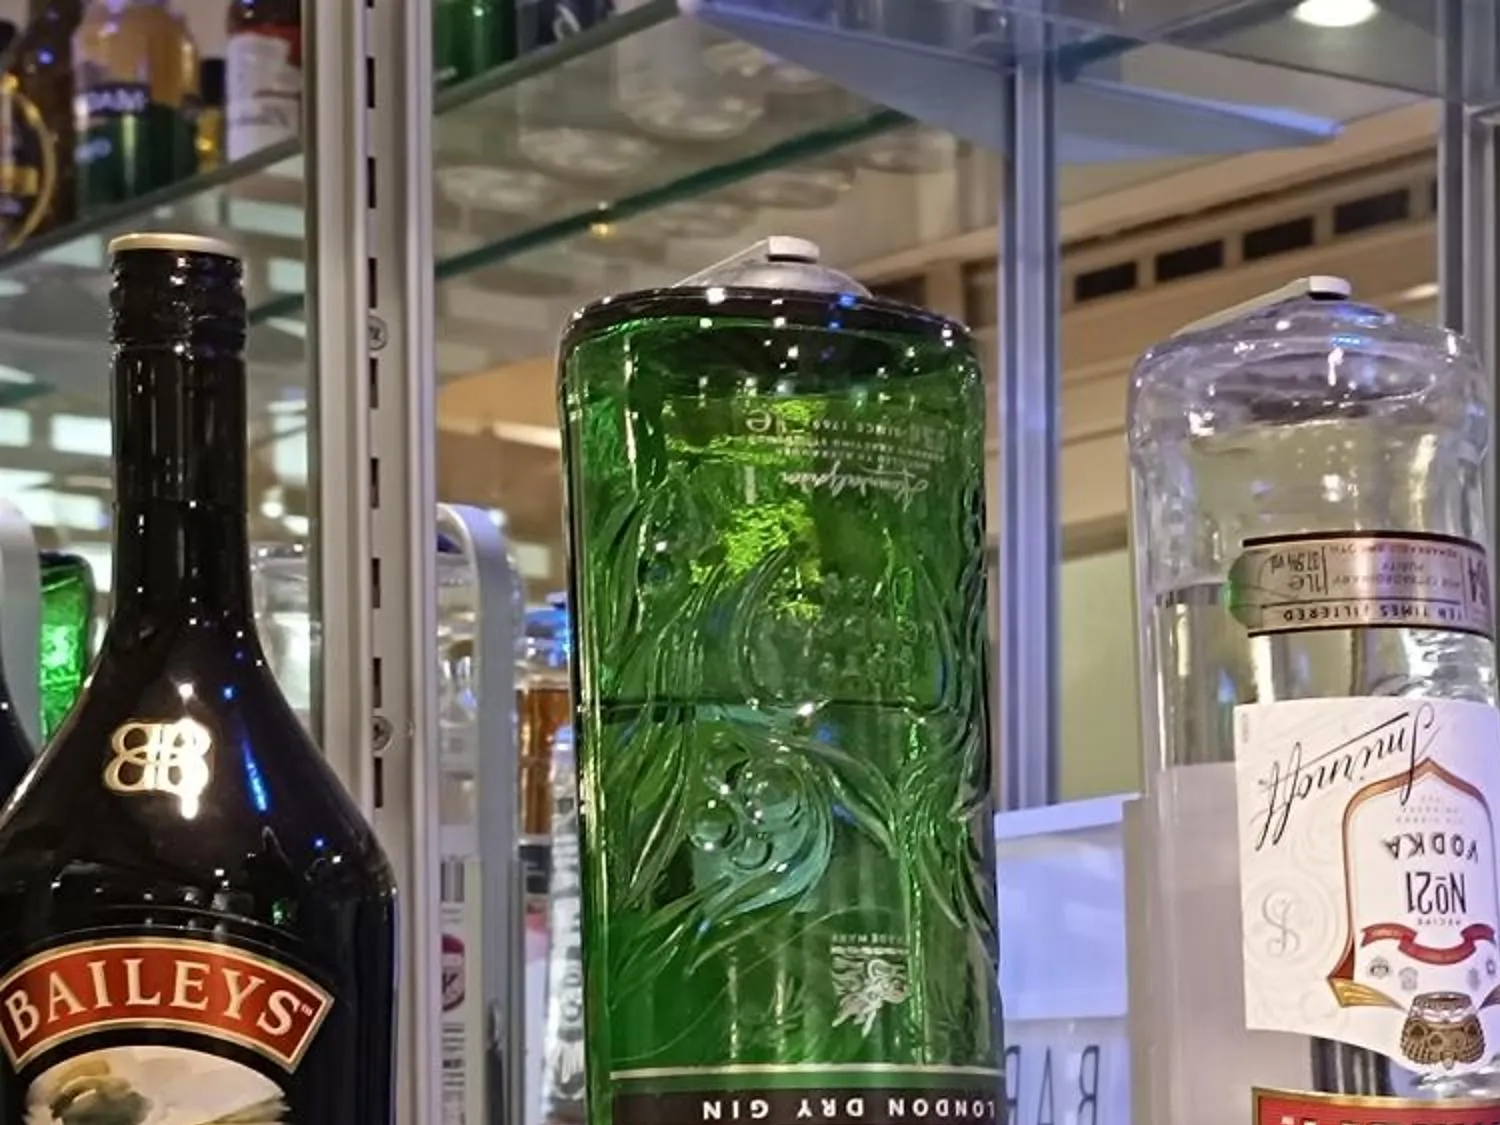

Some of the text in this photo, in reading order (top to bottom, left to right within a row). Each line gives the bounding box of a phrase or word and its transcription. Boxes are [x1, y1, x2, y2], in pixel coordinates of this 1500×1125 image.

[1380, 605, 1428, 619] TIMES
[1381, 832, 1480, 865] VODKA
[3, 956, 299, 1042] BAILEYS
[702, 1097, 995, 1120] LONDON DRY GIN
